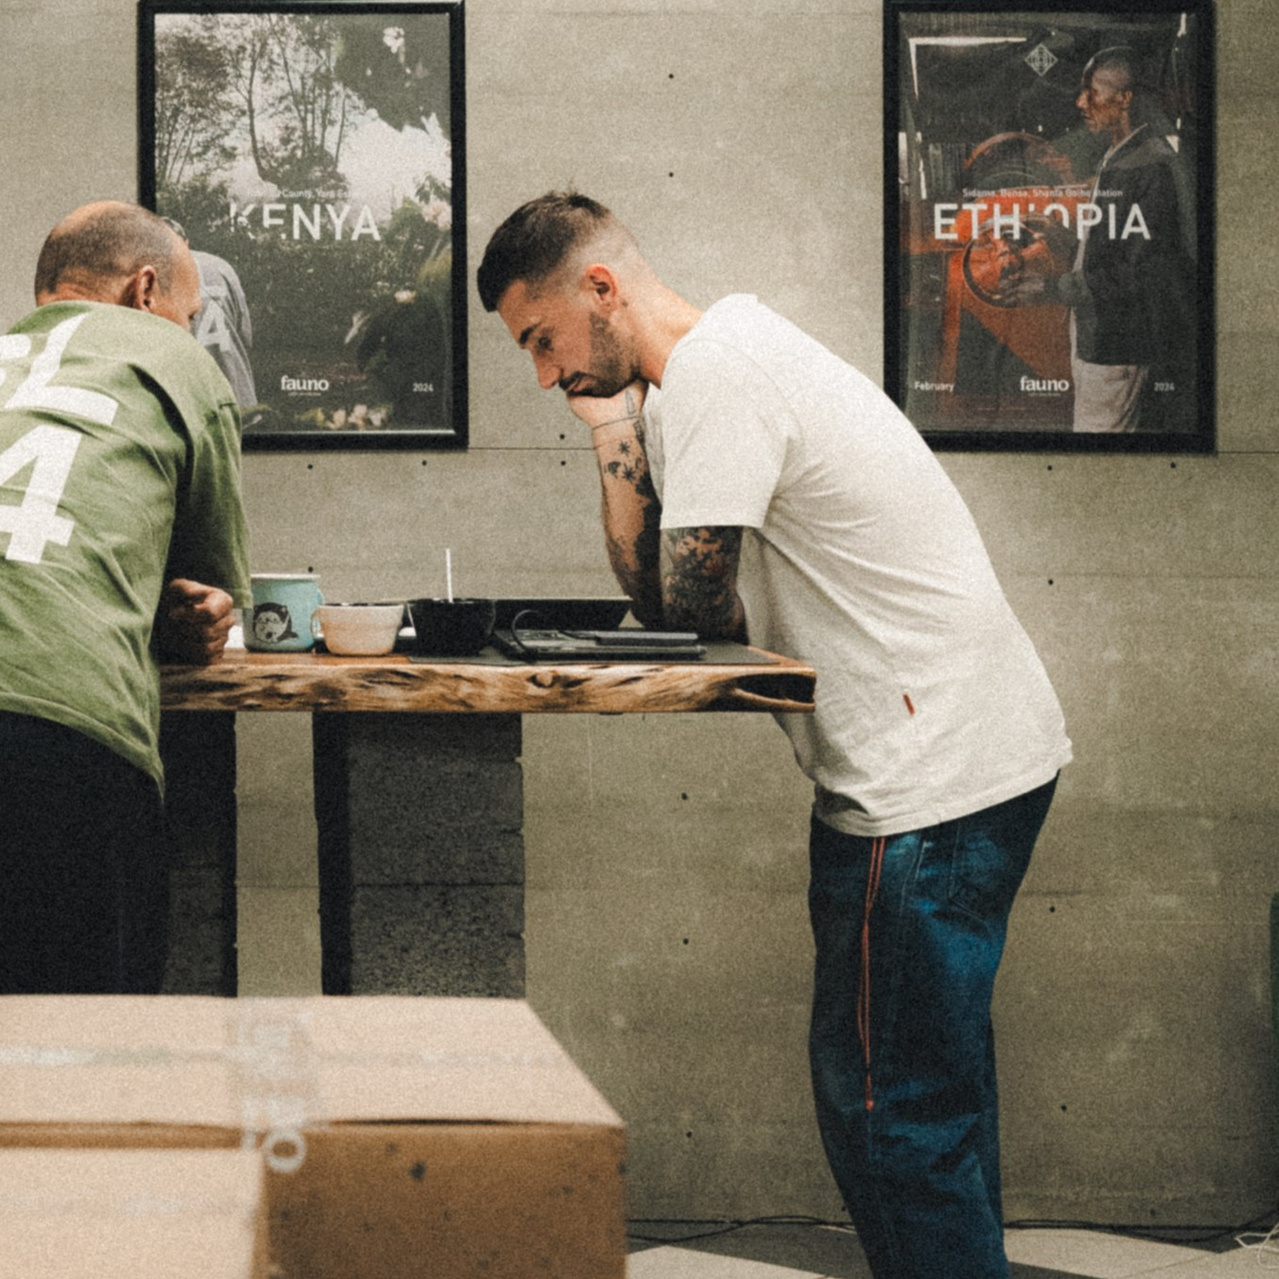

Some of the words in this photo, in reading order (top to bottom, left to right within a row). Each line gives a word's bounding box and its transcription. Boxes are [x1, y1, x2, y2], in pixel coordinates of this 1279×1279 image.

[1092, 188, 1124, 198] tation
[229, 203, 381, 241] KENYA
[933, 203, 1152, 240] ETHOPIA
[280, 374, 330, 391] fauno
[413, 382, 434, 392] 2024
[914, 380, 955, 394] February
[1020, 375, 1070, 392] fauno
